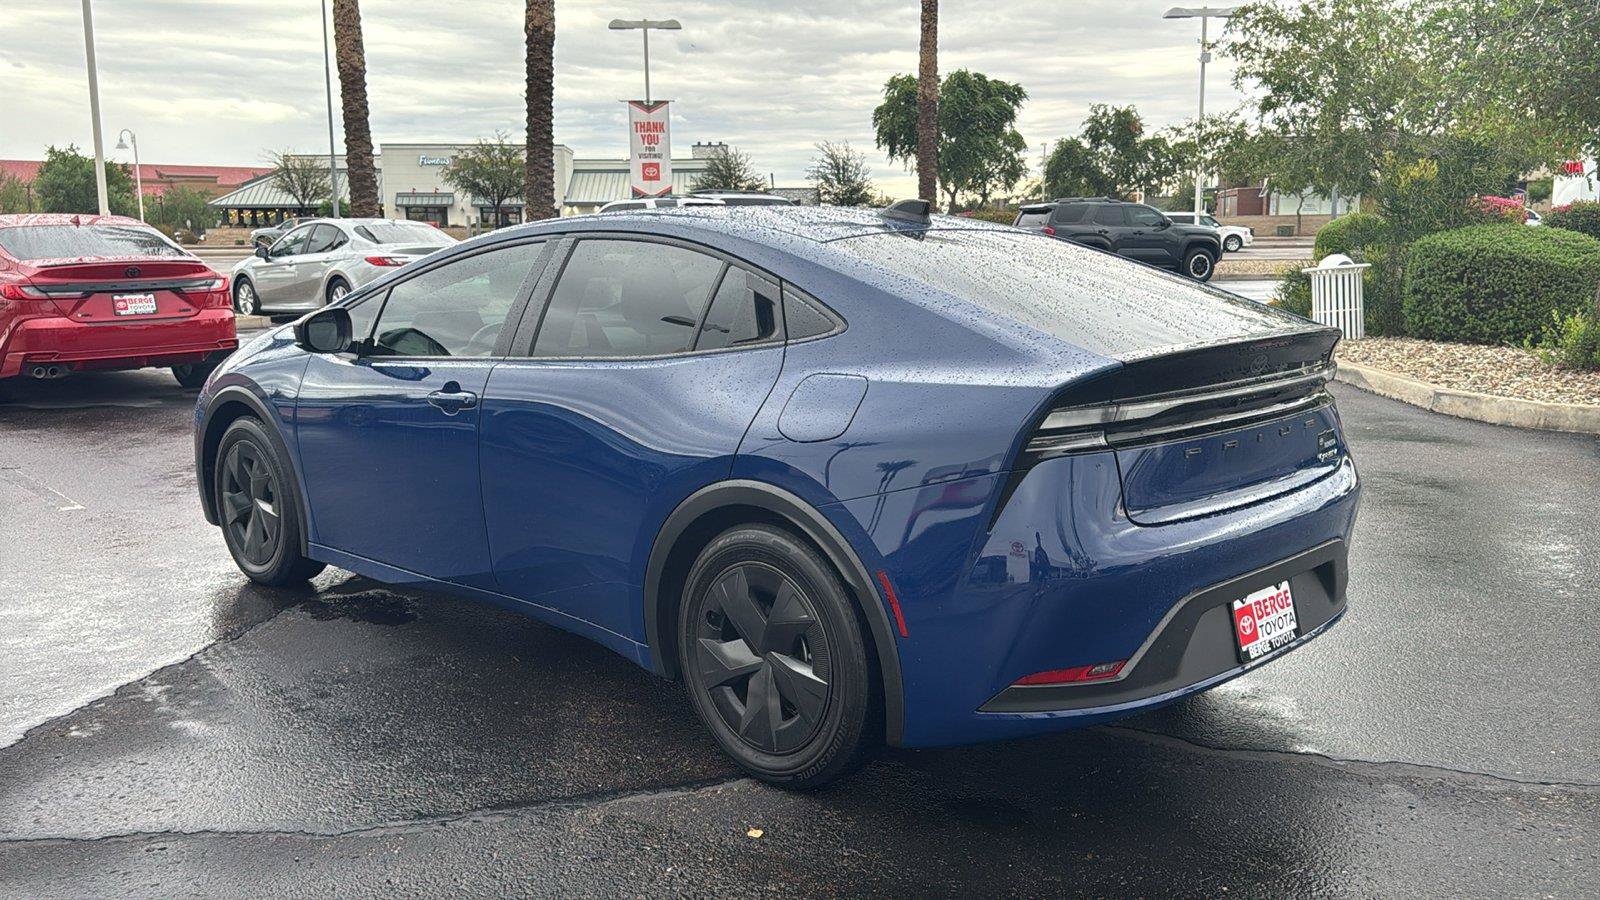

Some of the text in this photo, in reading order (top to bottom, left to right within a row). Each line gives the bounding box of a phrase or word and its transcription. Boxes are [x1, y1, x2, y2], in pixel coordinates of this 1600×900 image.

[634, 121, 665, 133] THANK
[641, 133, 660, 145] YOU
[1254, 589, 1291, 620] BERGE
[1259, 611, 1296, 638] TOYOTA
[1248, 630, 1296, 659] BERGE TOYOTA
